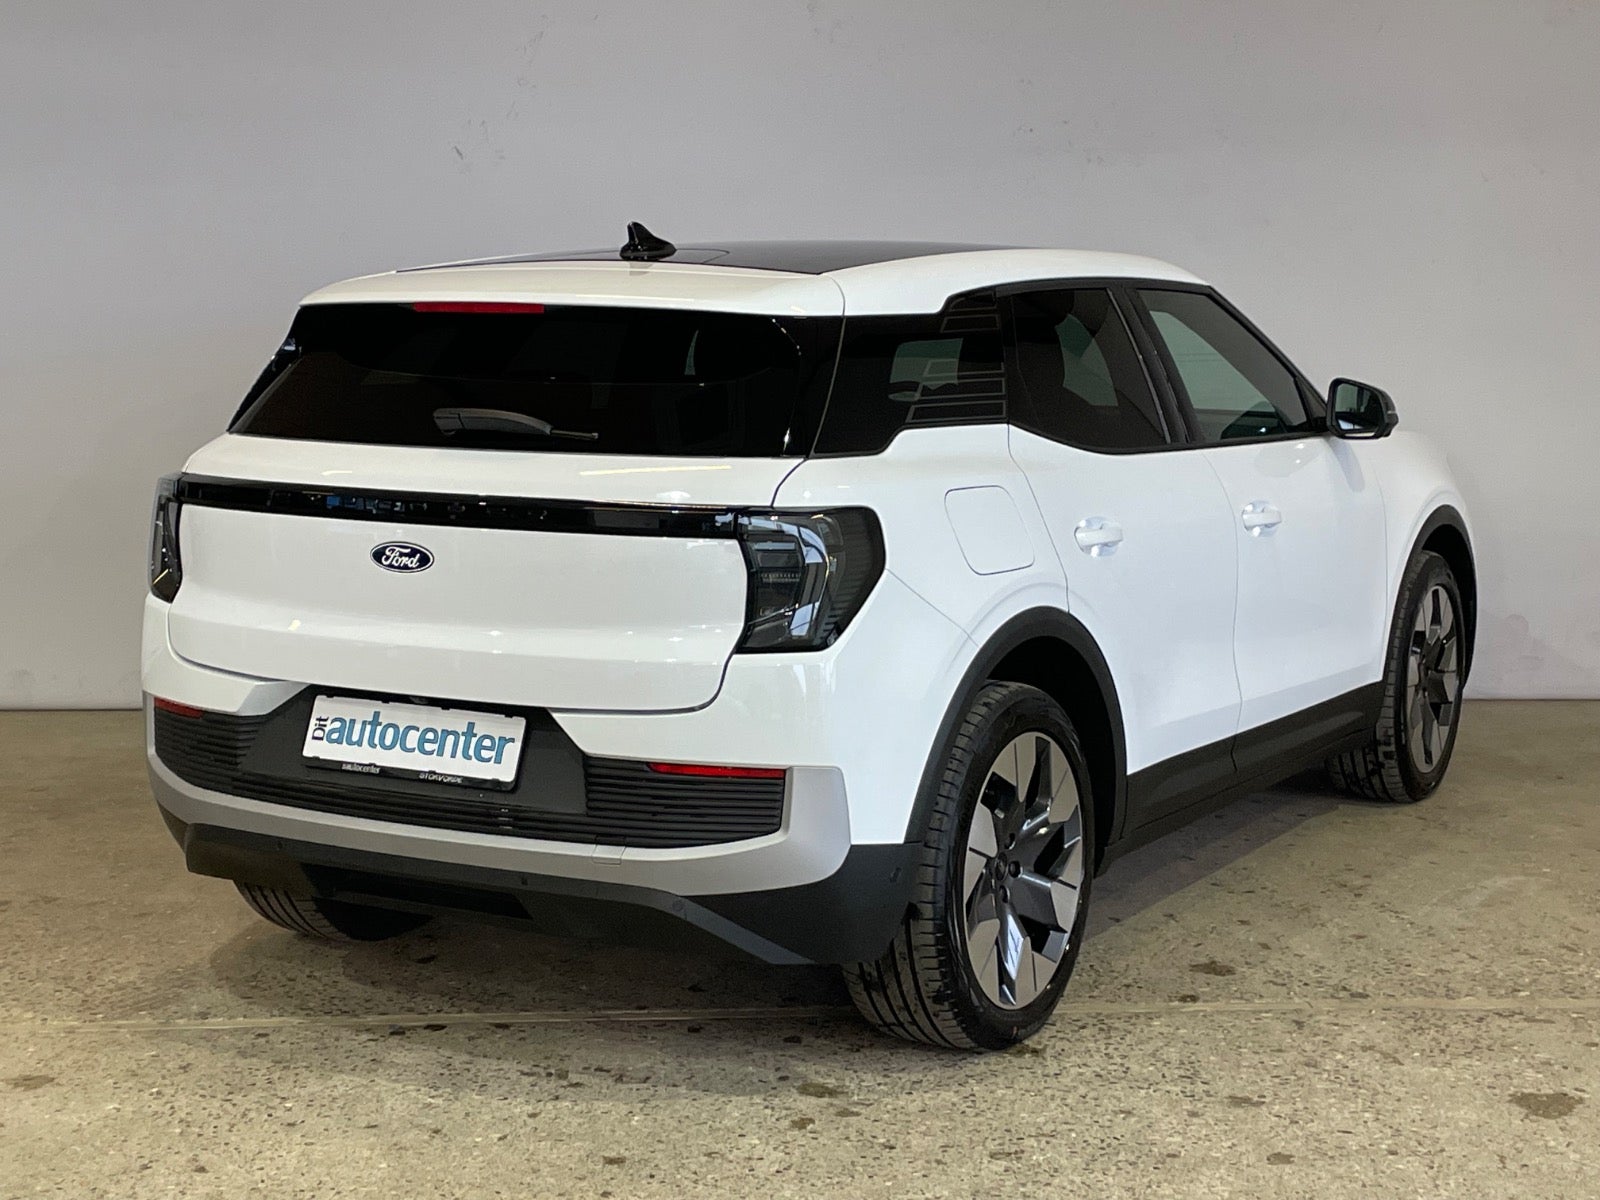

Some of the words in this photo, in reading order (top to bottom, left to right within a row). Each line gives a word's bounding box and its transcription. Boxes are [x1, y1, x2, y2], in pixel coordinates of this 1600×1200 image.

[381, 546, 420, 568] Ford
[312, 716, 329, 741] Dit
[325, 711, 515, 764] autocenter
